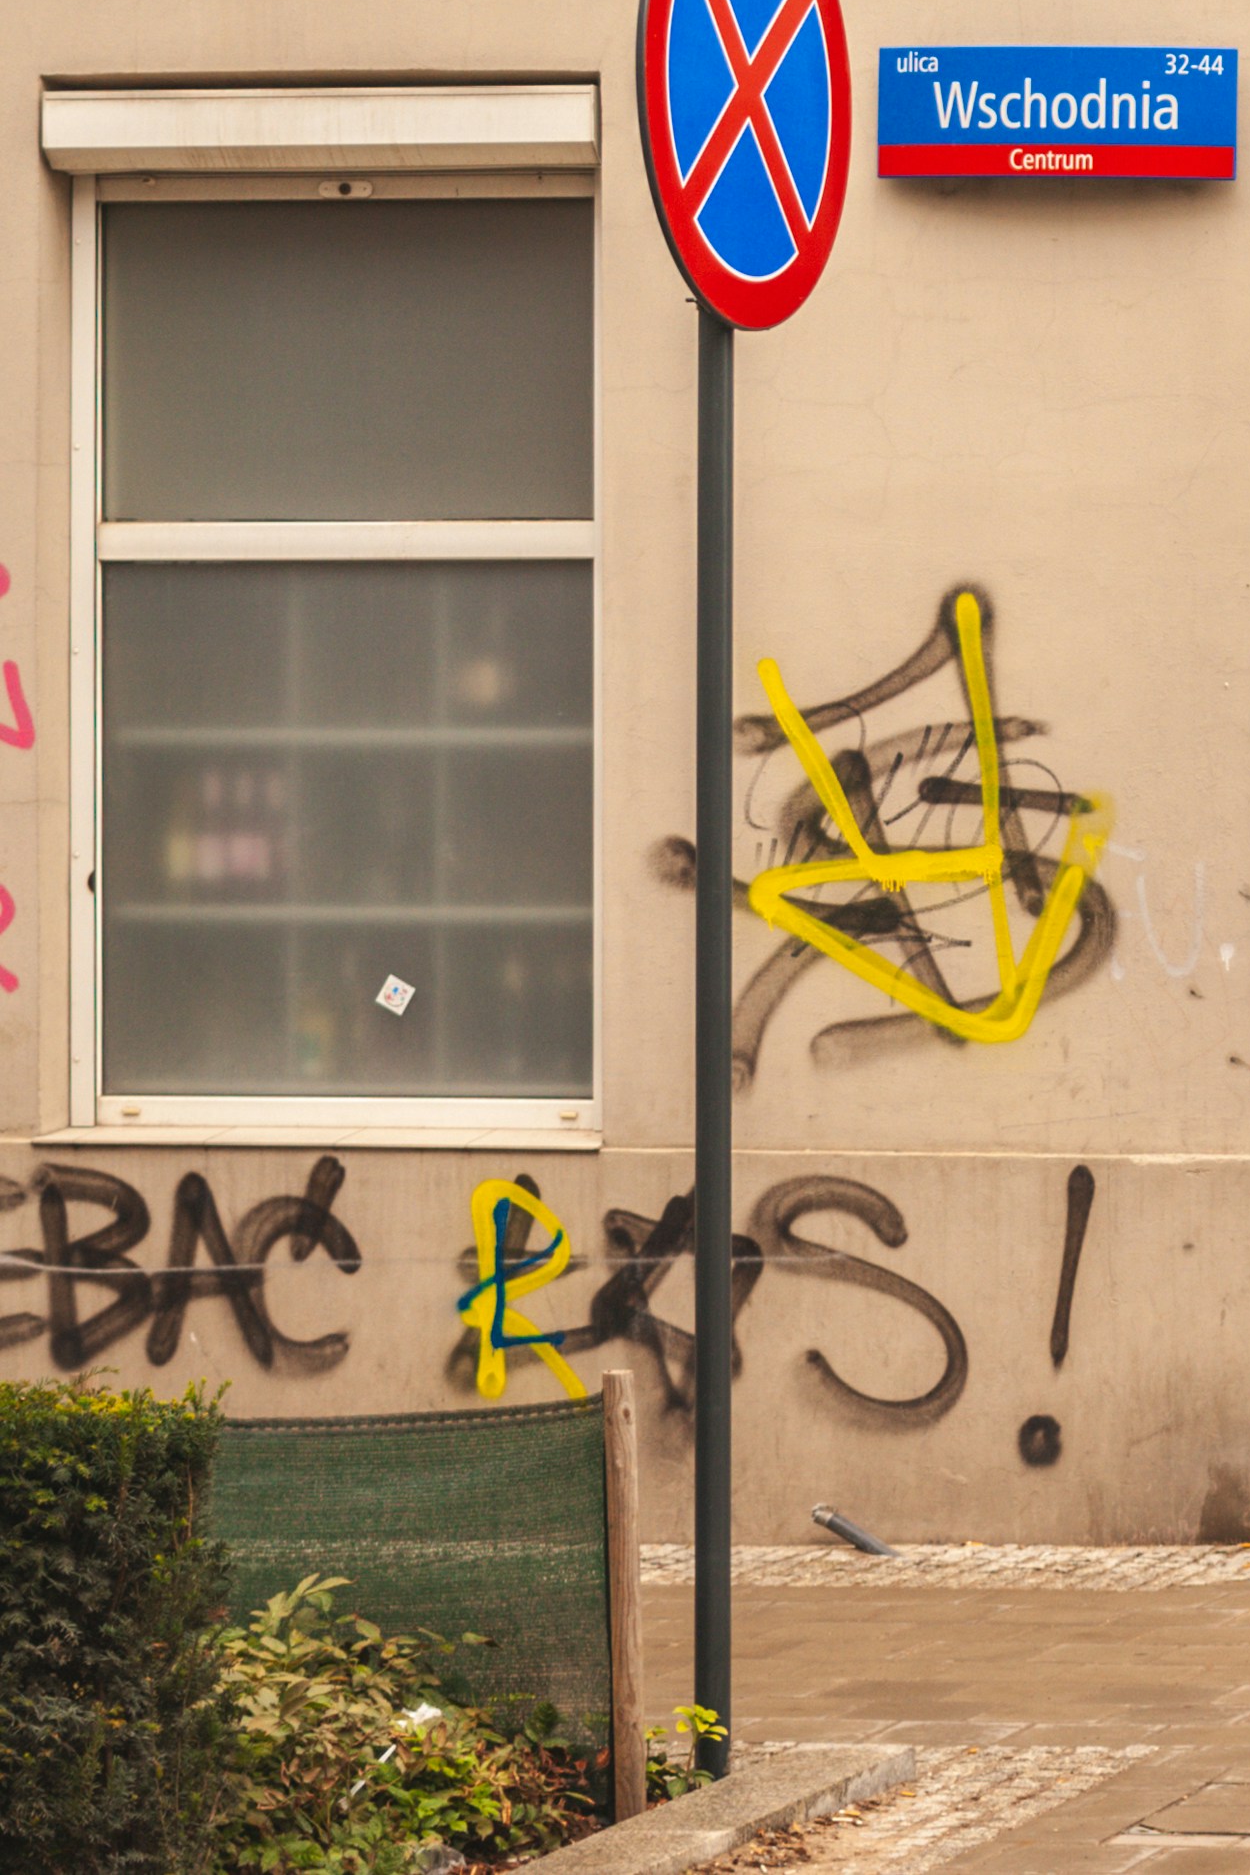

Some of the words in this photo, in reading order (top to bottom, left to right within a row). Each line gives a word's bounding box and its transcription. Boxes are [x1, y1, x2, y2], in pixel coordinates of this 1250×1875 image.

[896, 51, 939, 74] ulica
[1164, 53, 1225, 76] 32-44
[933, 77, 1179, 131] Wschodnia
[1009, 148, 1094, 171] Centrum
